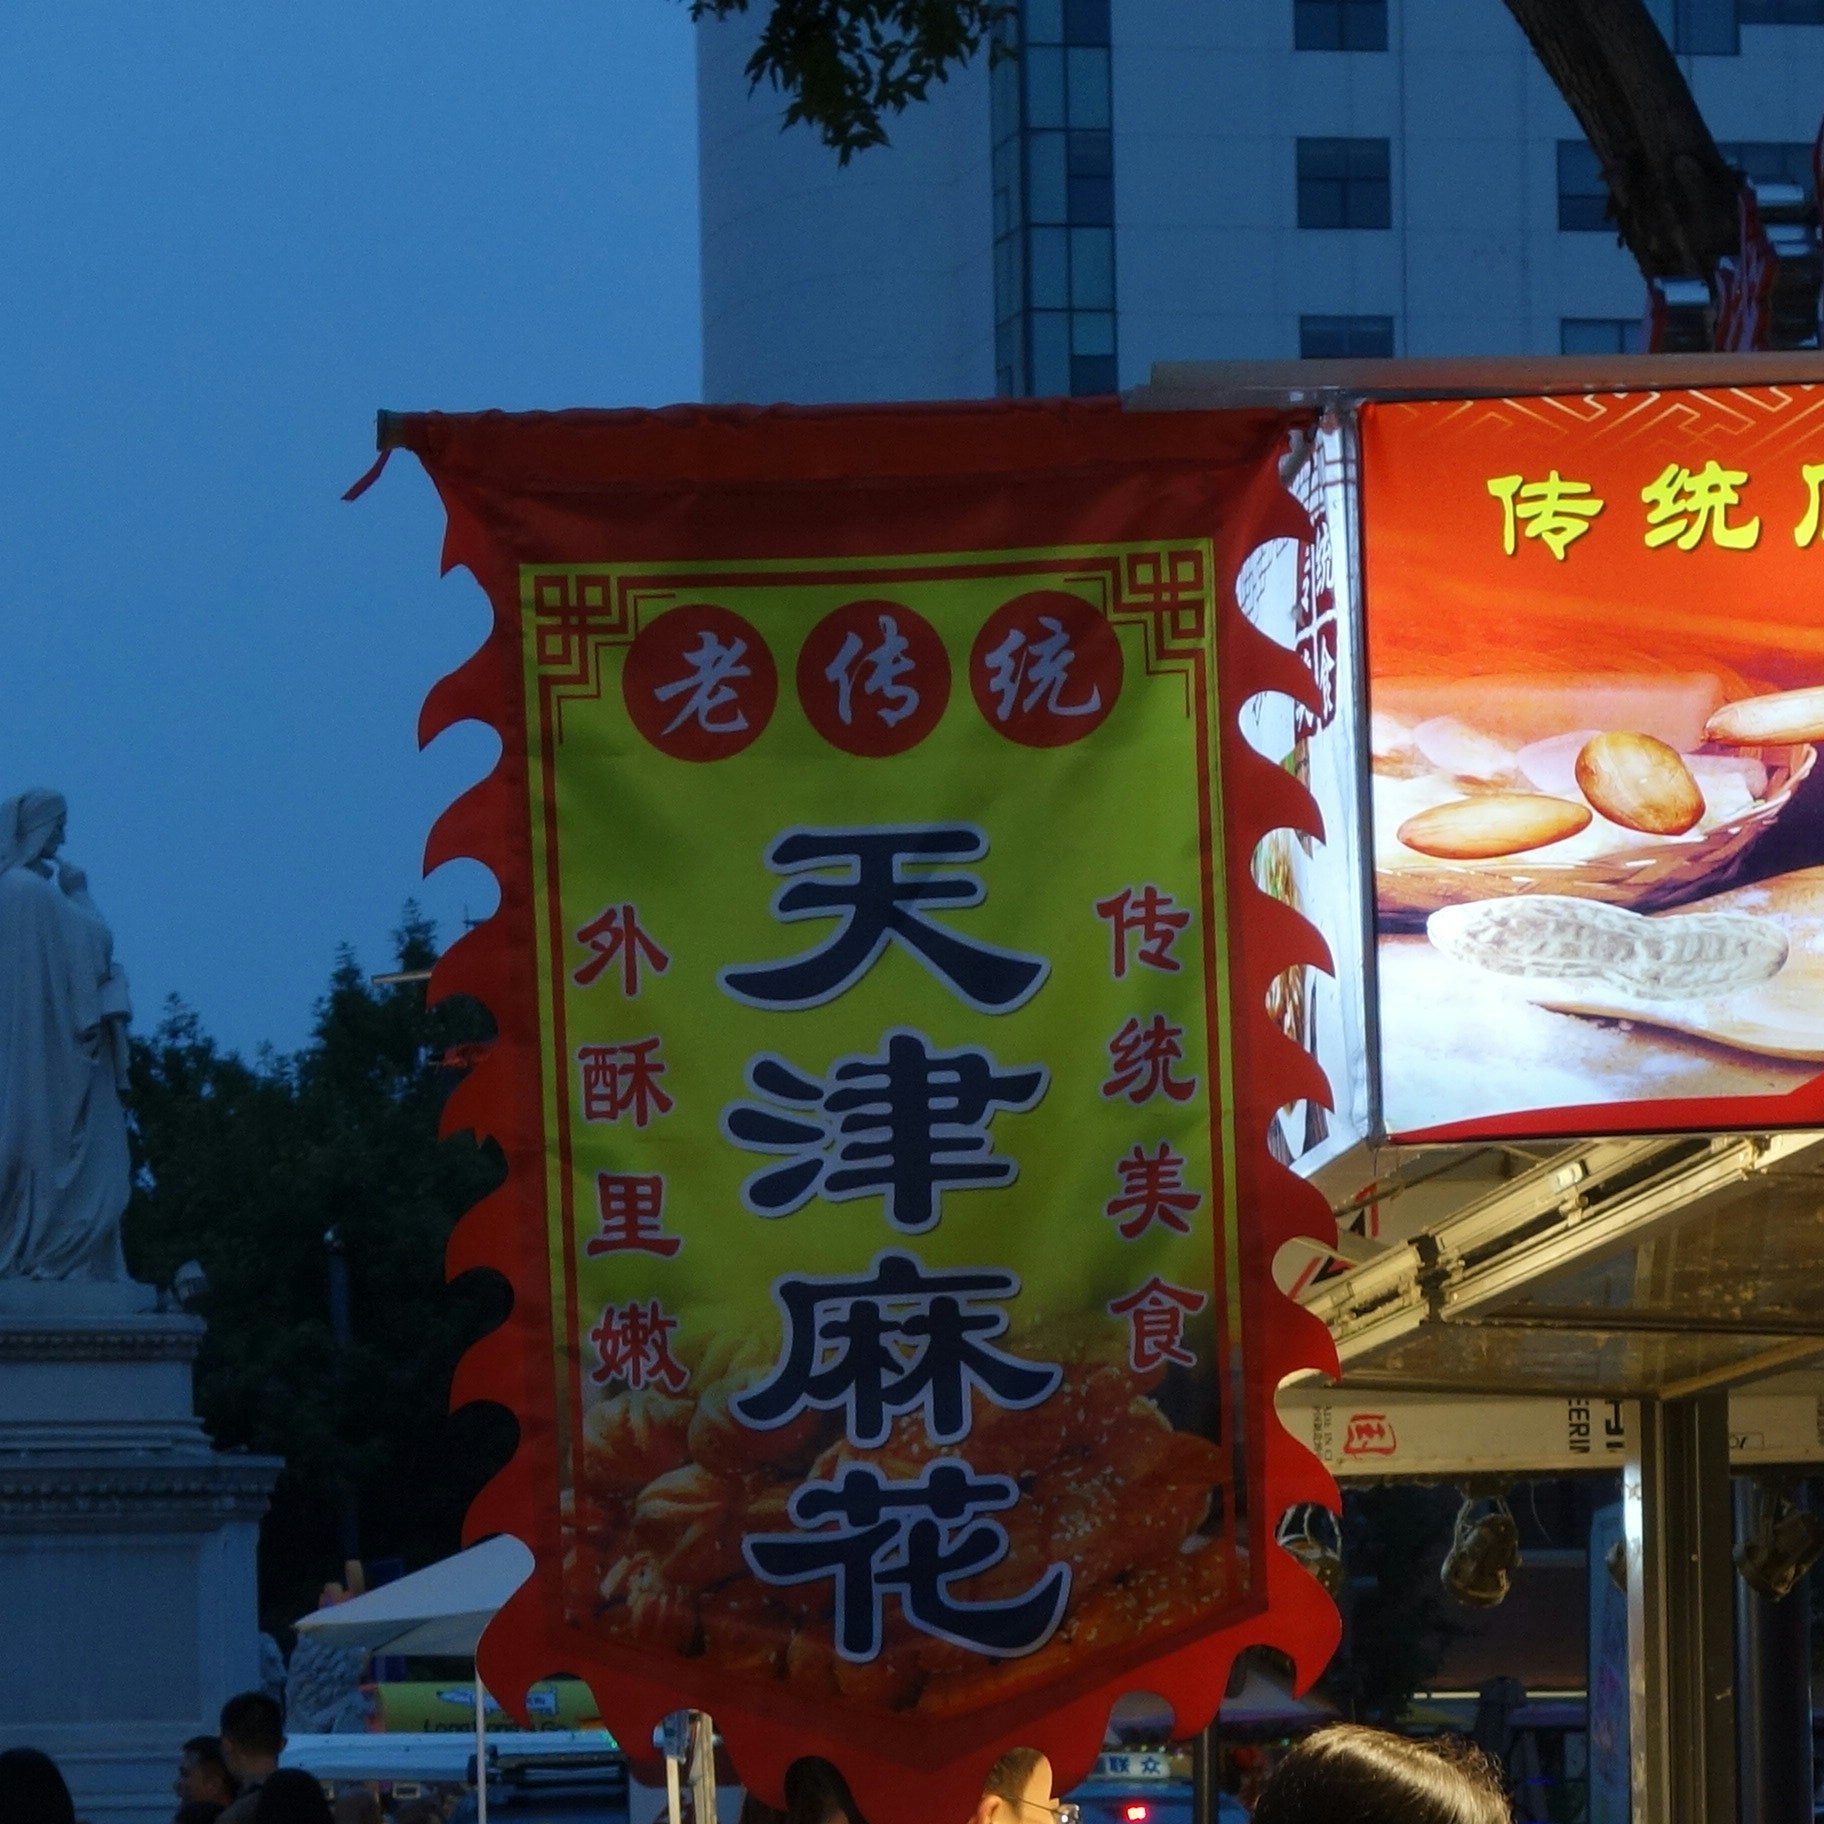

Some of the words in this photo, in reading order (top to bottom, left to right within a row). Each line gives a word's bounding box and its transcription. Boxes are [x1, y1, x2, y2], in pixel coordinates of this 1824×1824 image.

[655, 612, 1107, 738] 老传统
[574, 902, 689, 1392] 外酥里嫩
[719, 822, 1072, 1664] 天津麻花
[1095, 885, 1210, 1370] 传统美食
